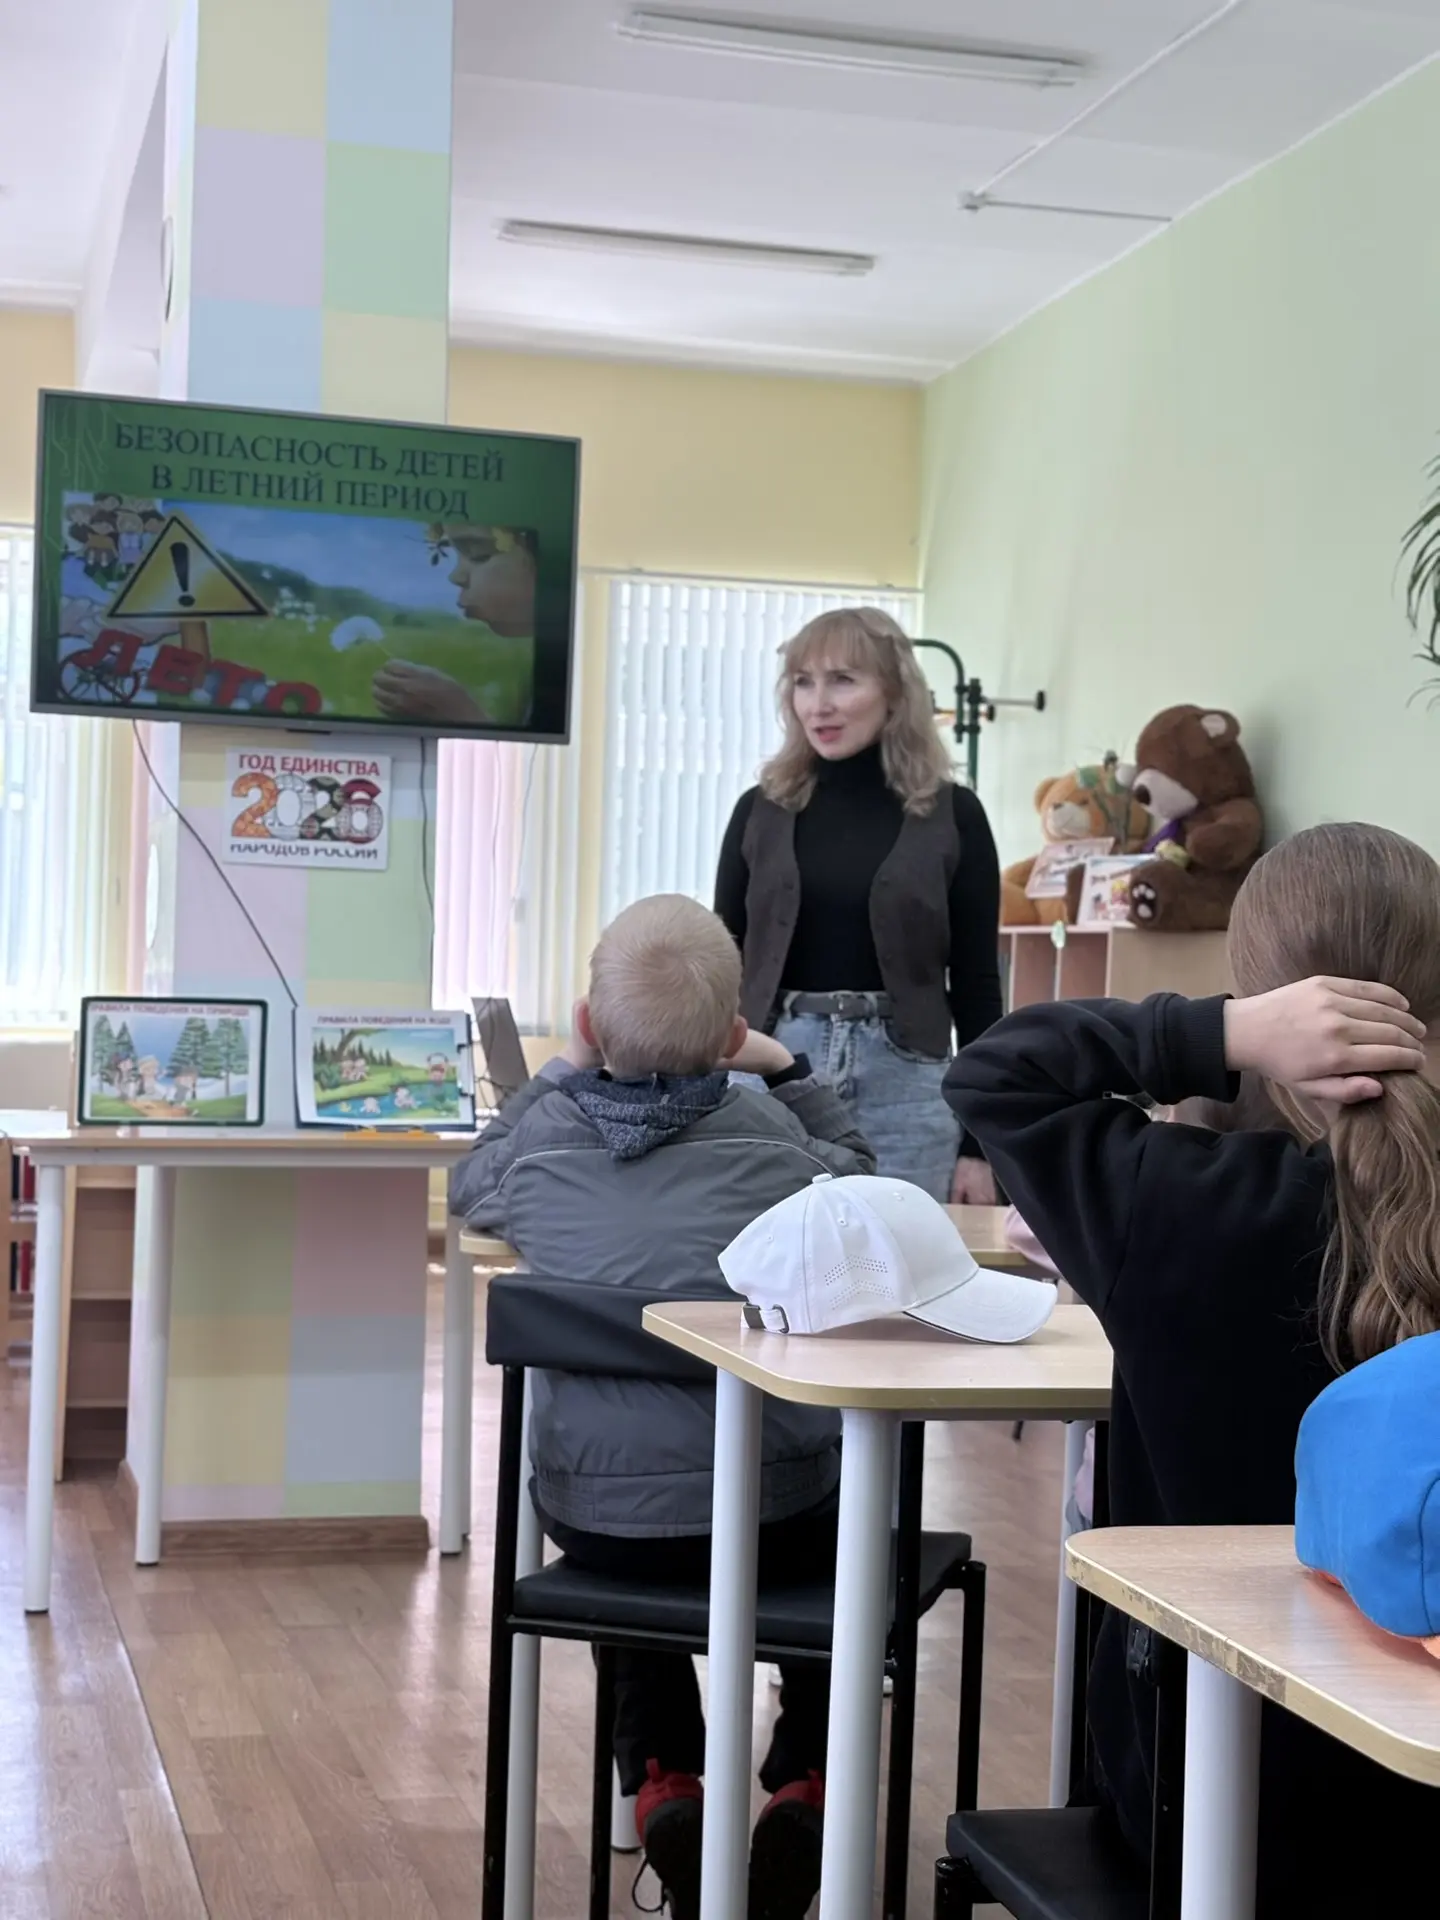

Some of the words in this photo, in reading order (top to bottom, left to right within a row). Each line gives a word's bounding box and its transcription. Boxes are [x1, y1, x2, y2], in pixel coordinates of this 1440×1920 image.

[115, 422, 388, 471] БЕЗОПАСНОСТЬ
[395, 447, 506, 482] ДЕТЕЙ
[152, 464, 173, 490] В
[180, 466, 324, 503] ЛЕТНИЙ
[335, 479, 470, 521] ПЕРИОД
[71, 628, 323, 714] ЛЕТО
[238, 753, 277, 774] ГОД
[280, 756, 381, 777] ЕДИНСТВА
[231, 771, 385, 845] 2026
[230, 843, 311, 858] НАРОДОВ
[314, 847, 379, 860] РОССИИ
[317, 1015, 360, 1024] ПРАВИЛА
[361, 1015, 413, 1025] ПОВЕДЕНИЯ
[414, 1016, 427, 1024] НА
